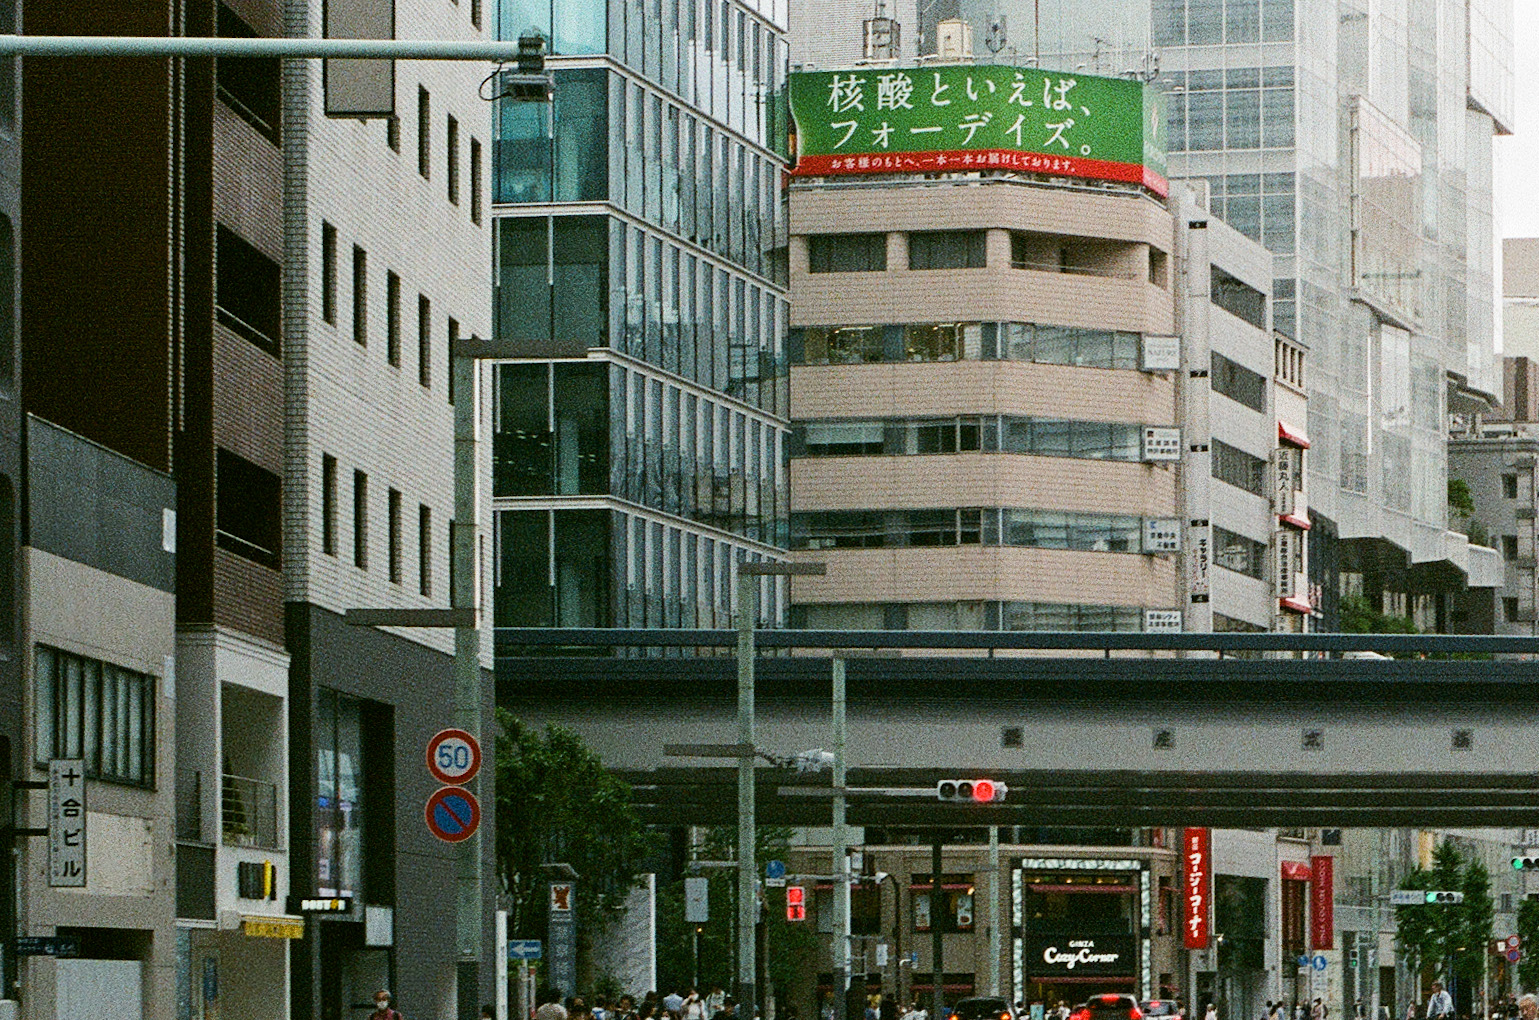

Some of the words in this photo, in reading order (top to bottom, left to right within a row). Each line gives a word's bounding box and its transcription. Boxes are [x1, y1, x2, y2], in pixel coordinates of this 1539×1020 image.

[828, 72, 1091, 116] 核酸といえば、
[830, 112, 1091, 156] フォーデイズ。
[438, 744, 469, 770] 50
[61, 767, 81, 877] 十合ビル
[1189, 853, 1203, 938] コージーコーナー
[1068, 940, 1095, 948] GINZA
